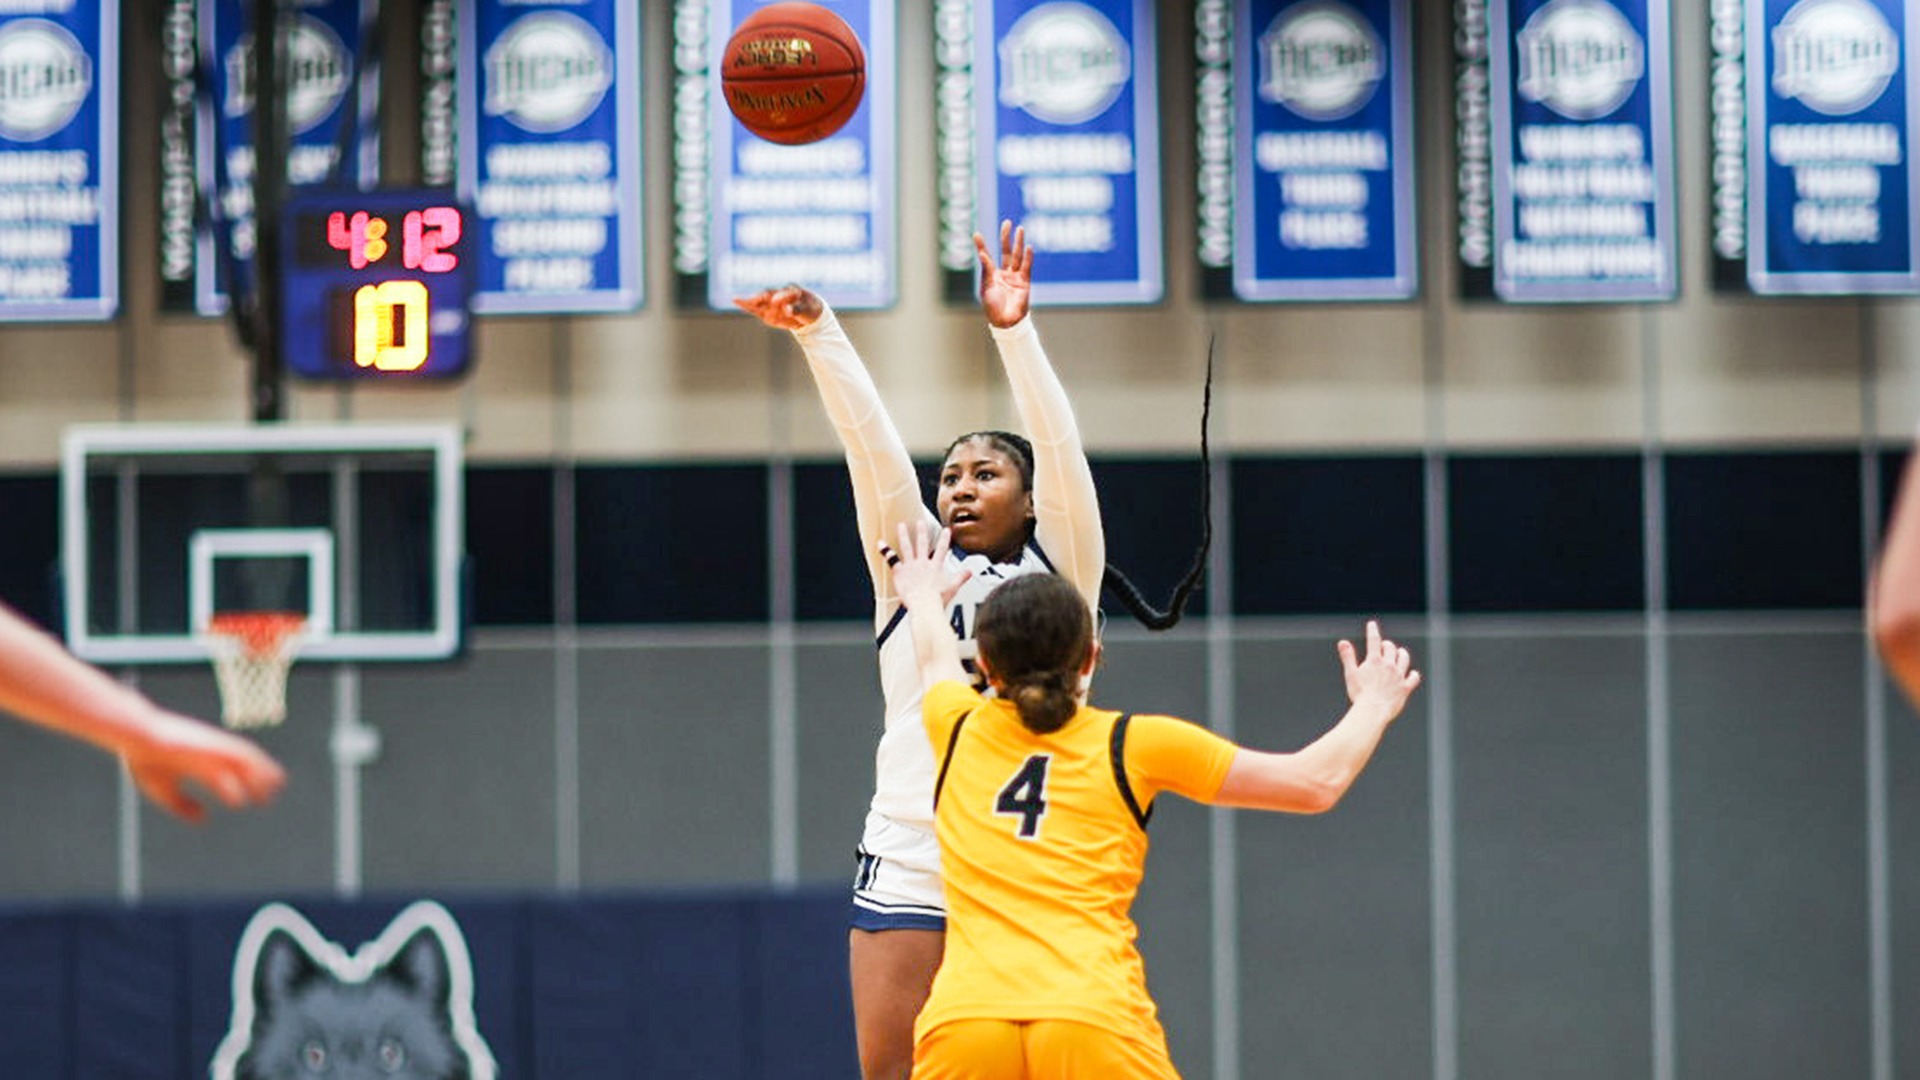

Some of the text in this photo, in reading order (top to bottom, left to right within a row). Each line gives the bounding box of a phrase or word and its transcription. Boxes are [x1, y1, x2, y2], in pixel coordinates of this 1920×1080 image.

[327, 206, 461, 273] 4:12
[355, 280, 428, 371] 10
[994, 753, 1052, 839] 4
